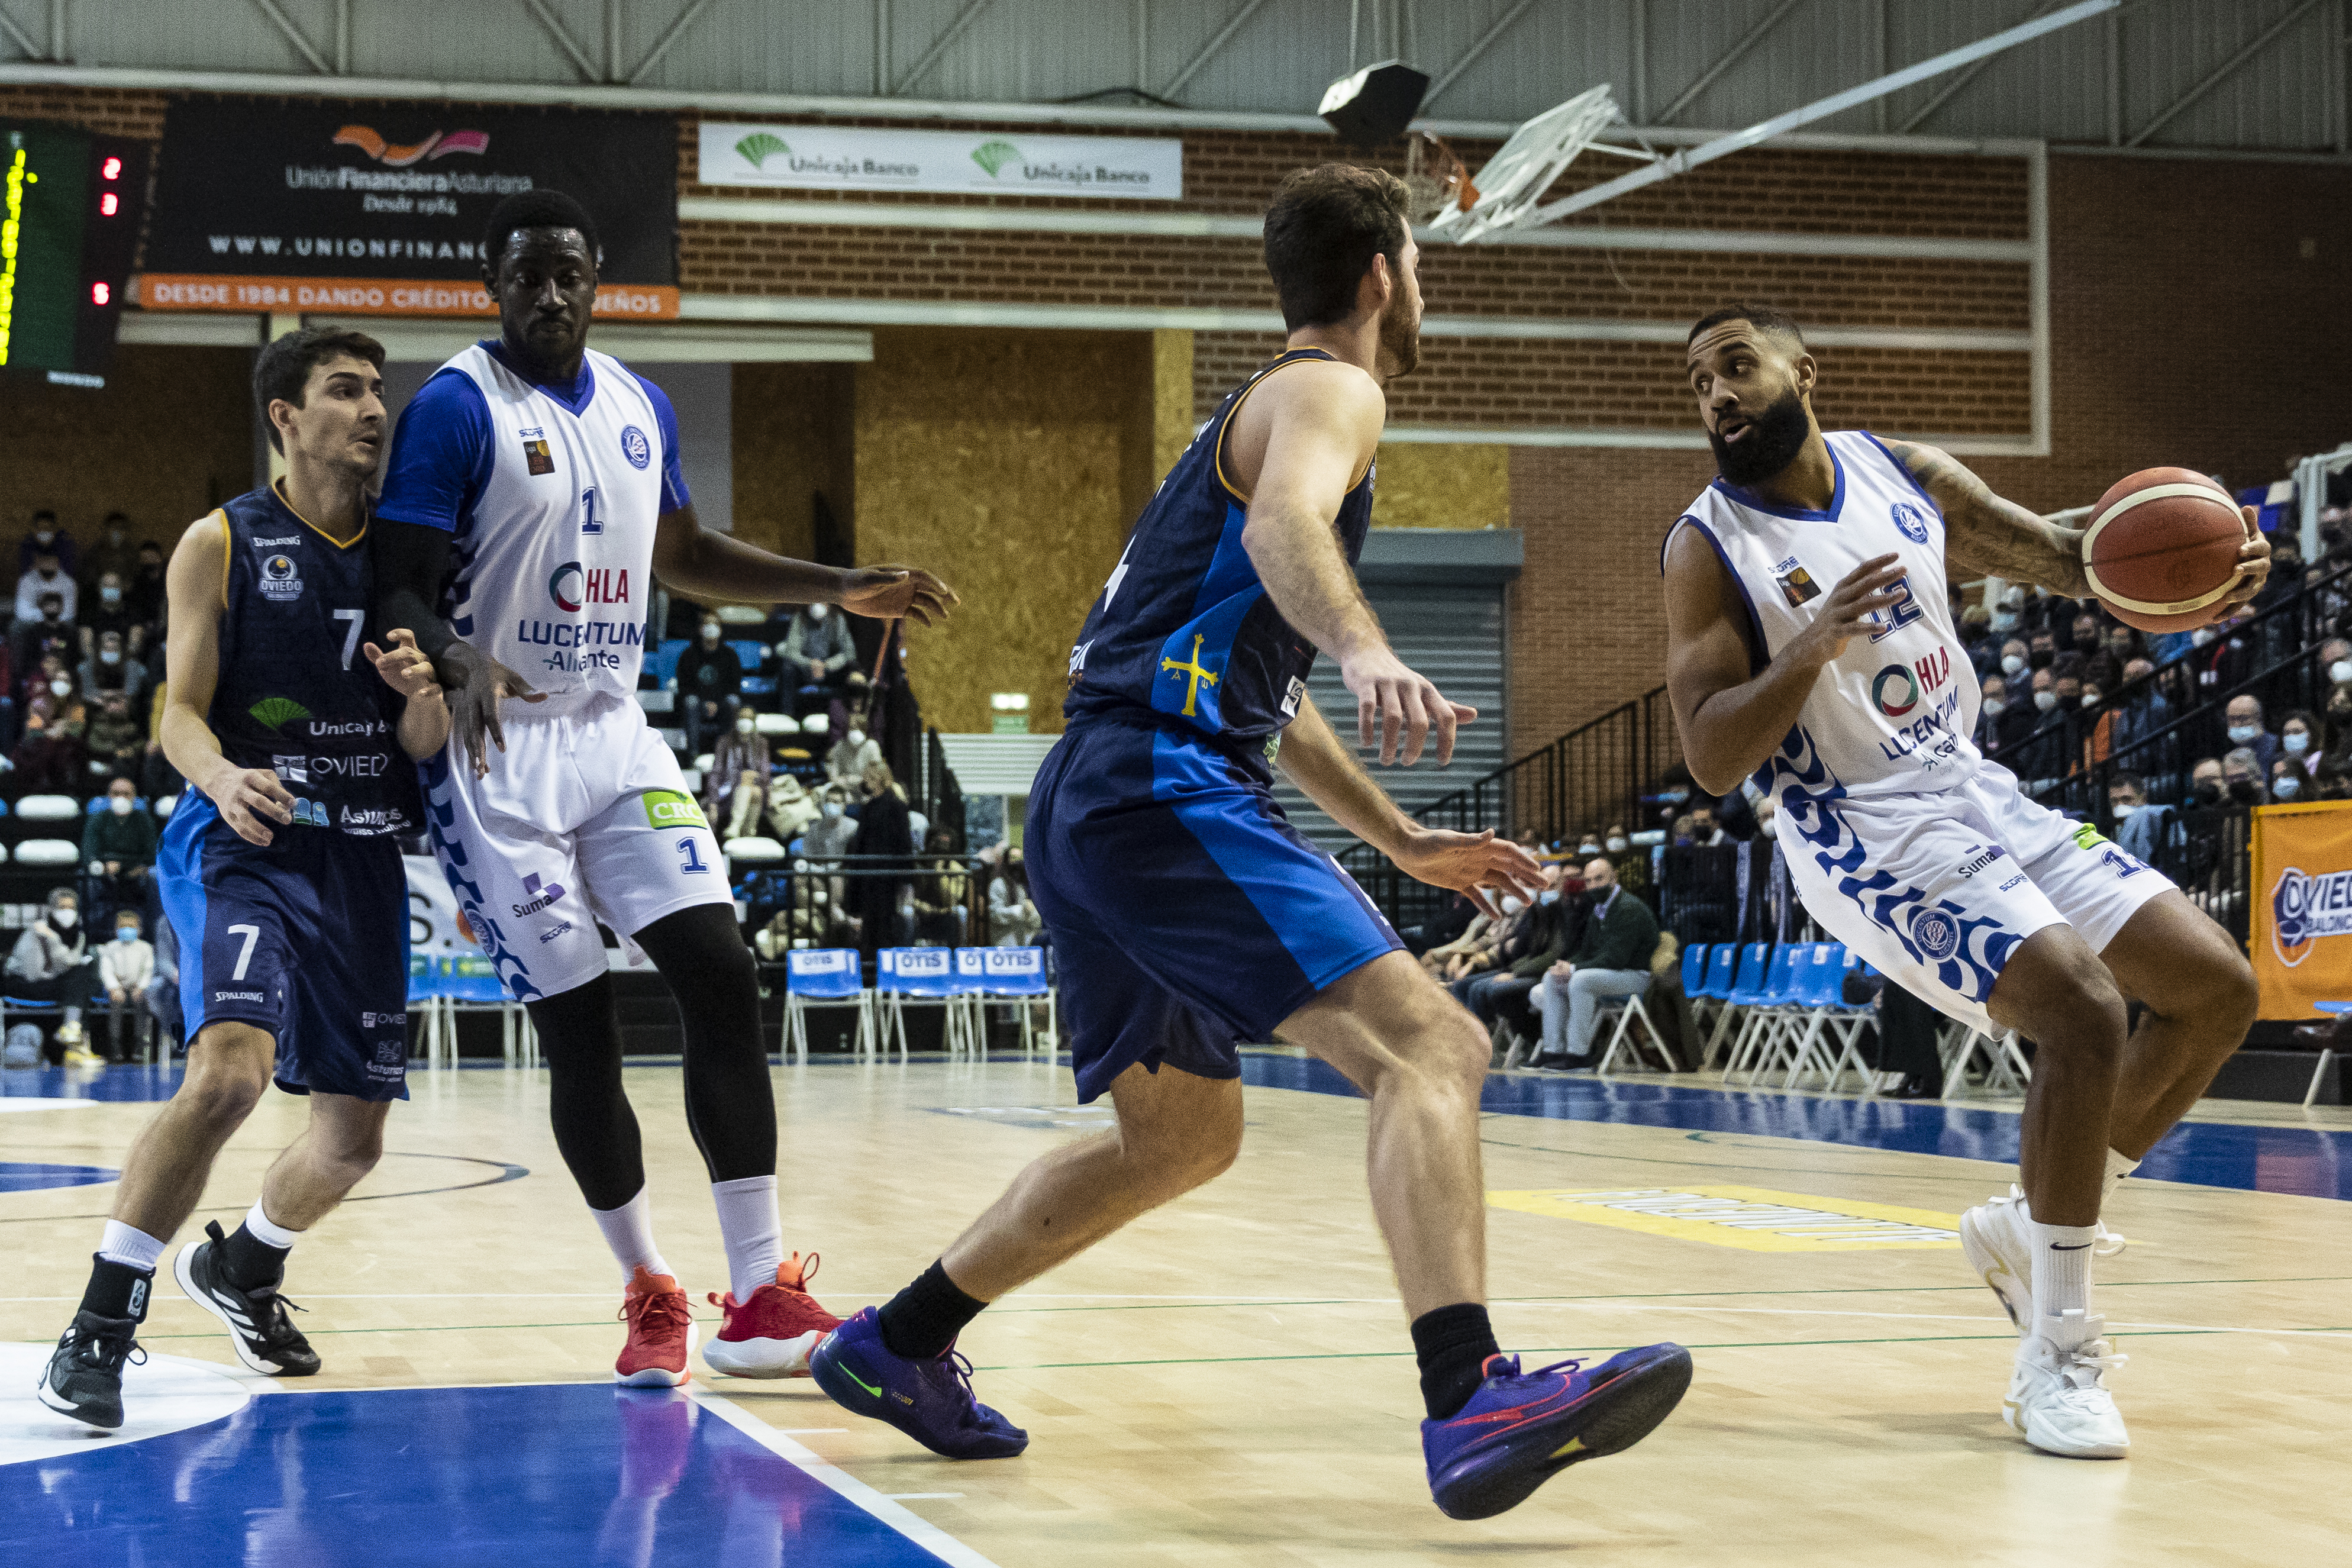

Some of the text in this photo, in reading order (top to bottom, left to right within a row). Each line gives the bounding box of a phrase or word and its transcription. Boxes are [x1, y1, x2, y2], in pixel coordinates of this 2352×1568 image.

[789, 153, 919, 179] Unicaja Banco
[1024, 162, 1150, 186] Unicaja Banco
[154, 282, 230, 304] DESDE
[238, 285, 290, 305] 1984
[298, 286, 385, 306] DANDO
[391, 288, 492, 309] CRÉDITO
[581, 486, 604, 535] 1
[261, 580, 302, 592] OVIEDO
[333, 609, 365, 671] 7
[676, 837, 710, 875] 1
[1958, 850, 1997, 879] Suma
[512, 893, 553, 918] Suma
[227, 924, 260, 980] 7
[901, 954, 941, 967] OTIS
[992, 954, 1033, 967] OTIS
[215, 991, 264, 1003] SPALDING
